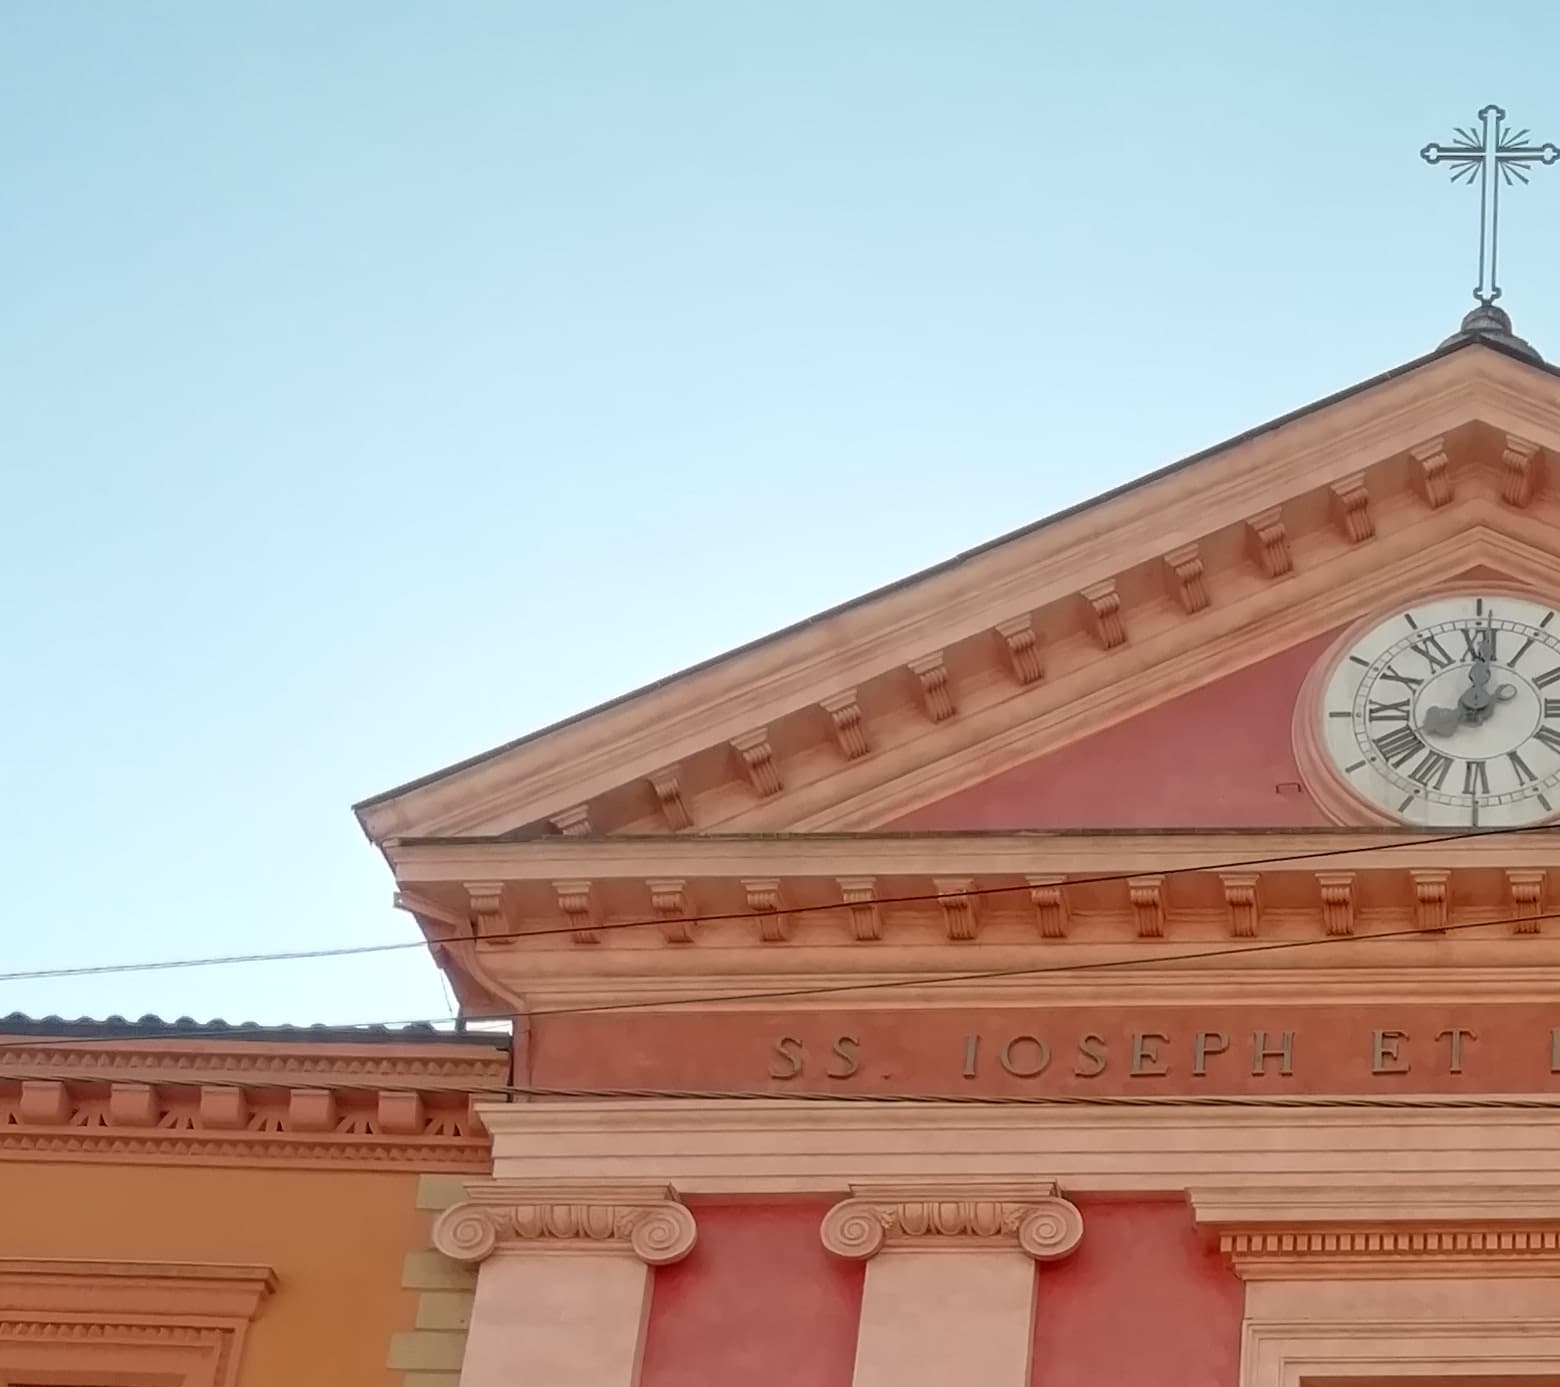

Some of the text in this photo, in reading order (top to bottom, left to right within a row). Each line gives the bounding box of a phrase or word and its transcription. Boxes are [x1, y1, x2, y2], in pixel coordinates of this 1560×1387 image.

[1411, 635, 1455, 674] XI
[1508, 638, 1535, 667] I
[1380, 665, 1424, 693] X
[1369, 699, 1410, 722] IX
[1373, 724, 1425, 769] VIII
[1408, 750, 1454, 790] VII
[1462, 761, 1490, 794] VI
[1507, 750, 1537, 786] V
[962, 1031, 1295, 1078] IOSEPH
[1371, 1028, 1478, 1075] ET
